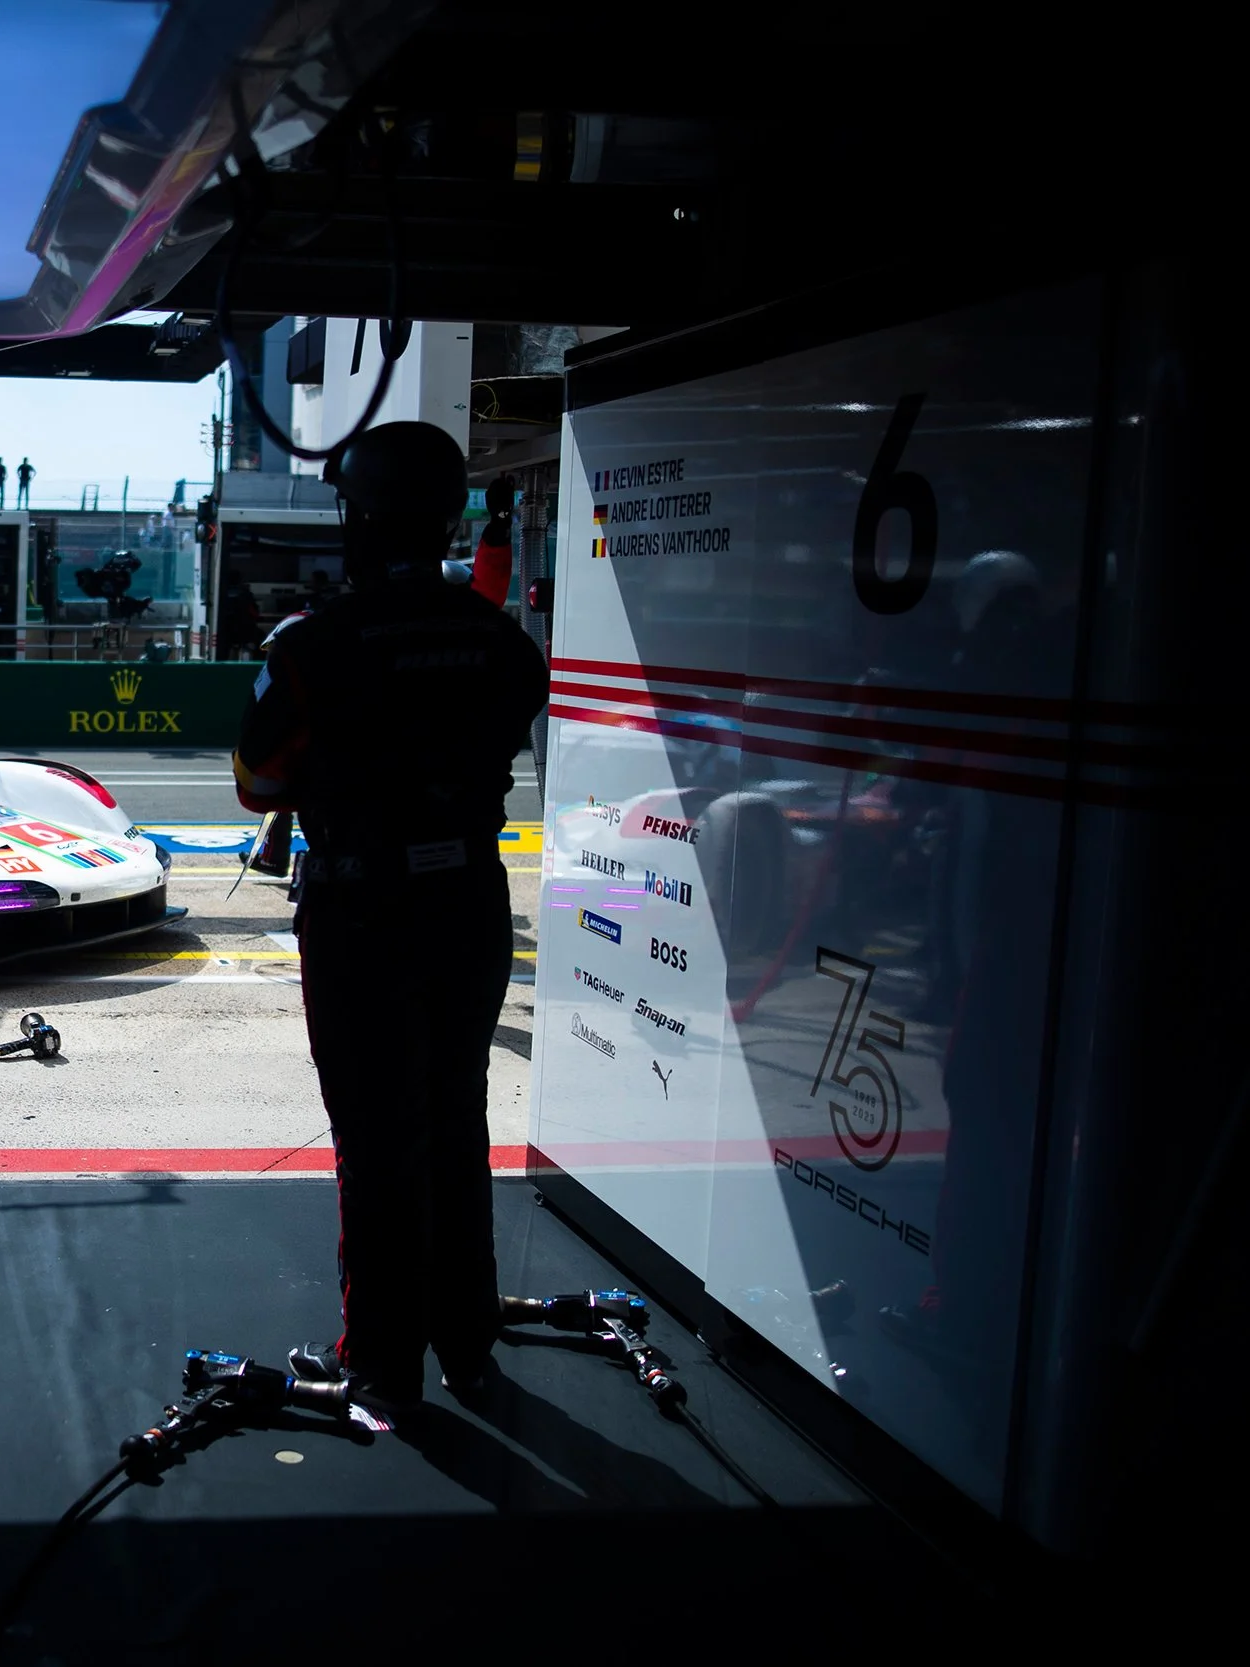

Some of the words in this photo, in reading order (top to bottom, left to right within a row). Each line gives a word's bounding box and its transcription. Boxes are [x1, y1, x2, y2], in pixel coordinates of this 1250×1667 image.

[612, 465, 645, 490] KEVIN
[648, 458, 685, 485] ESTRE
[611, 499, 647, 524] ANDRE
[650, 491, 711, 520] LOTTERER
[853, 393, 938, 615] 6
[609, 533, 659, 557] LAURENS
[661, 527, 730, 554] VANTHOOR
[69, 711, 182, 733] ROLEX
[19, 824, 64, 842] 6
[642, 815, 700, 845] PENSKE
[582, 850, 625, 880] HELLER
[645, 870, 678, 902] Mobil
[680, 882, 692, 906] 1
[590, 919, 618, 938] MICHELIN
[650, 937, 687, 972] BOSS
[635, 998, 686, 1036] Snap-on
[581, 1023, 616, 1056] Multimatic
[810, 945, 905, 1172] 75
[854, 1089, 876, 1108] 1948
[852, 1105, 875, 1125] 2023
[774, 1147, 930, 1257] PORSCHE
